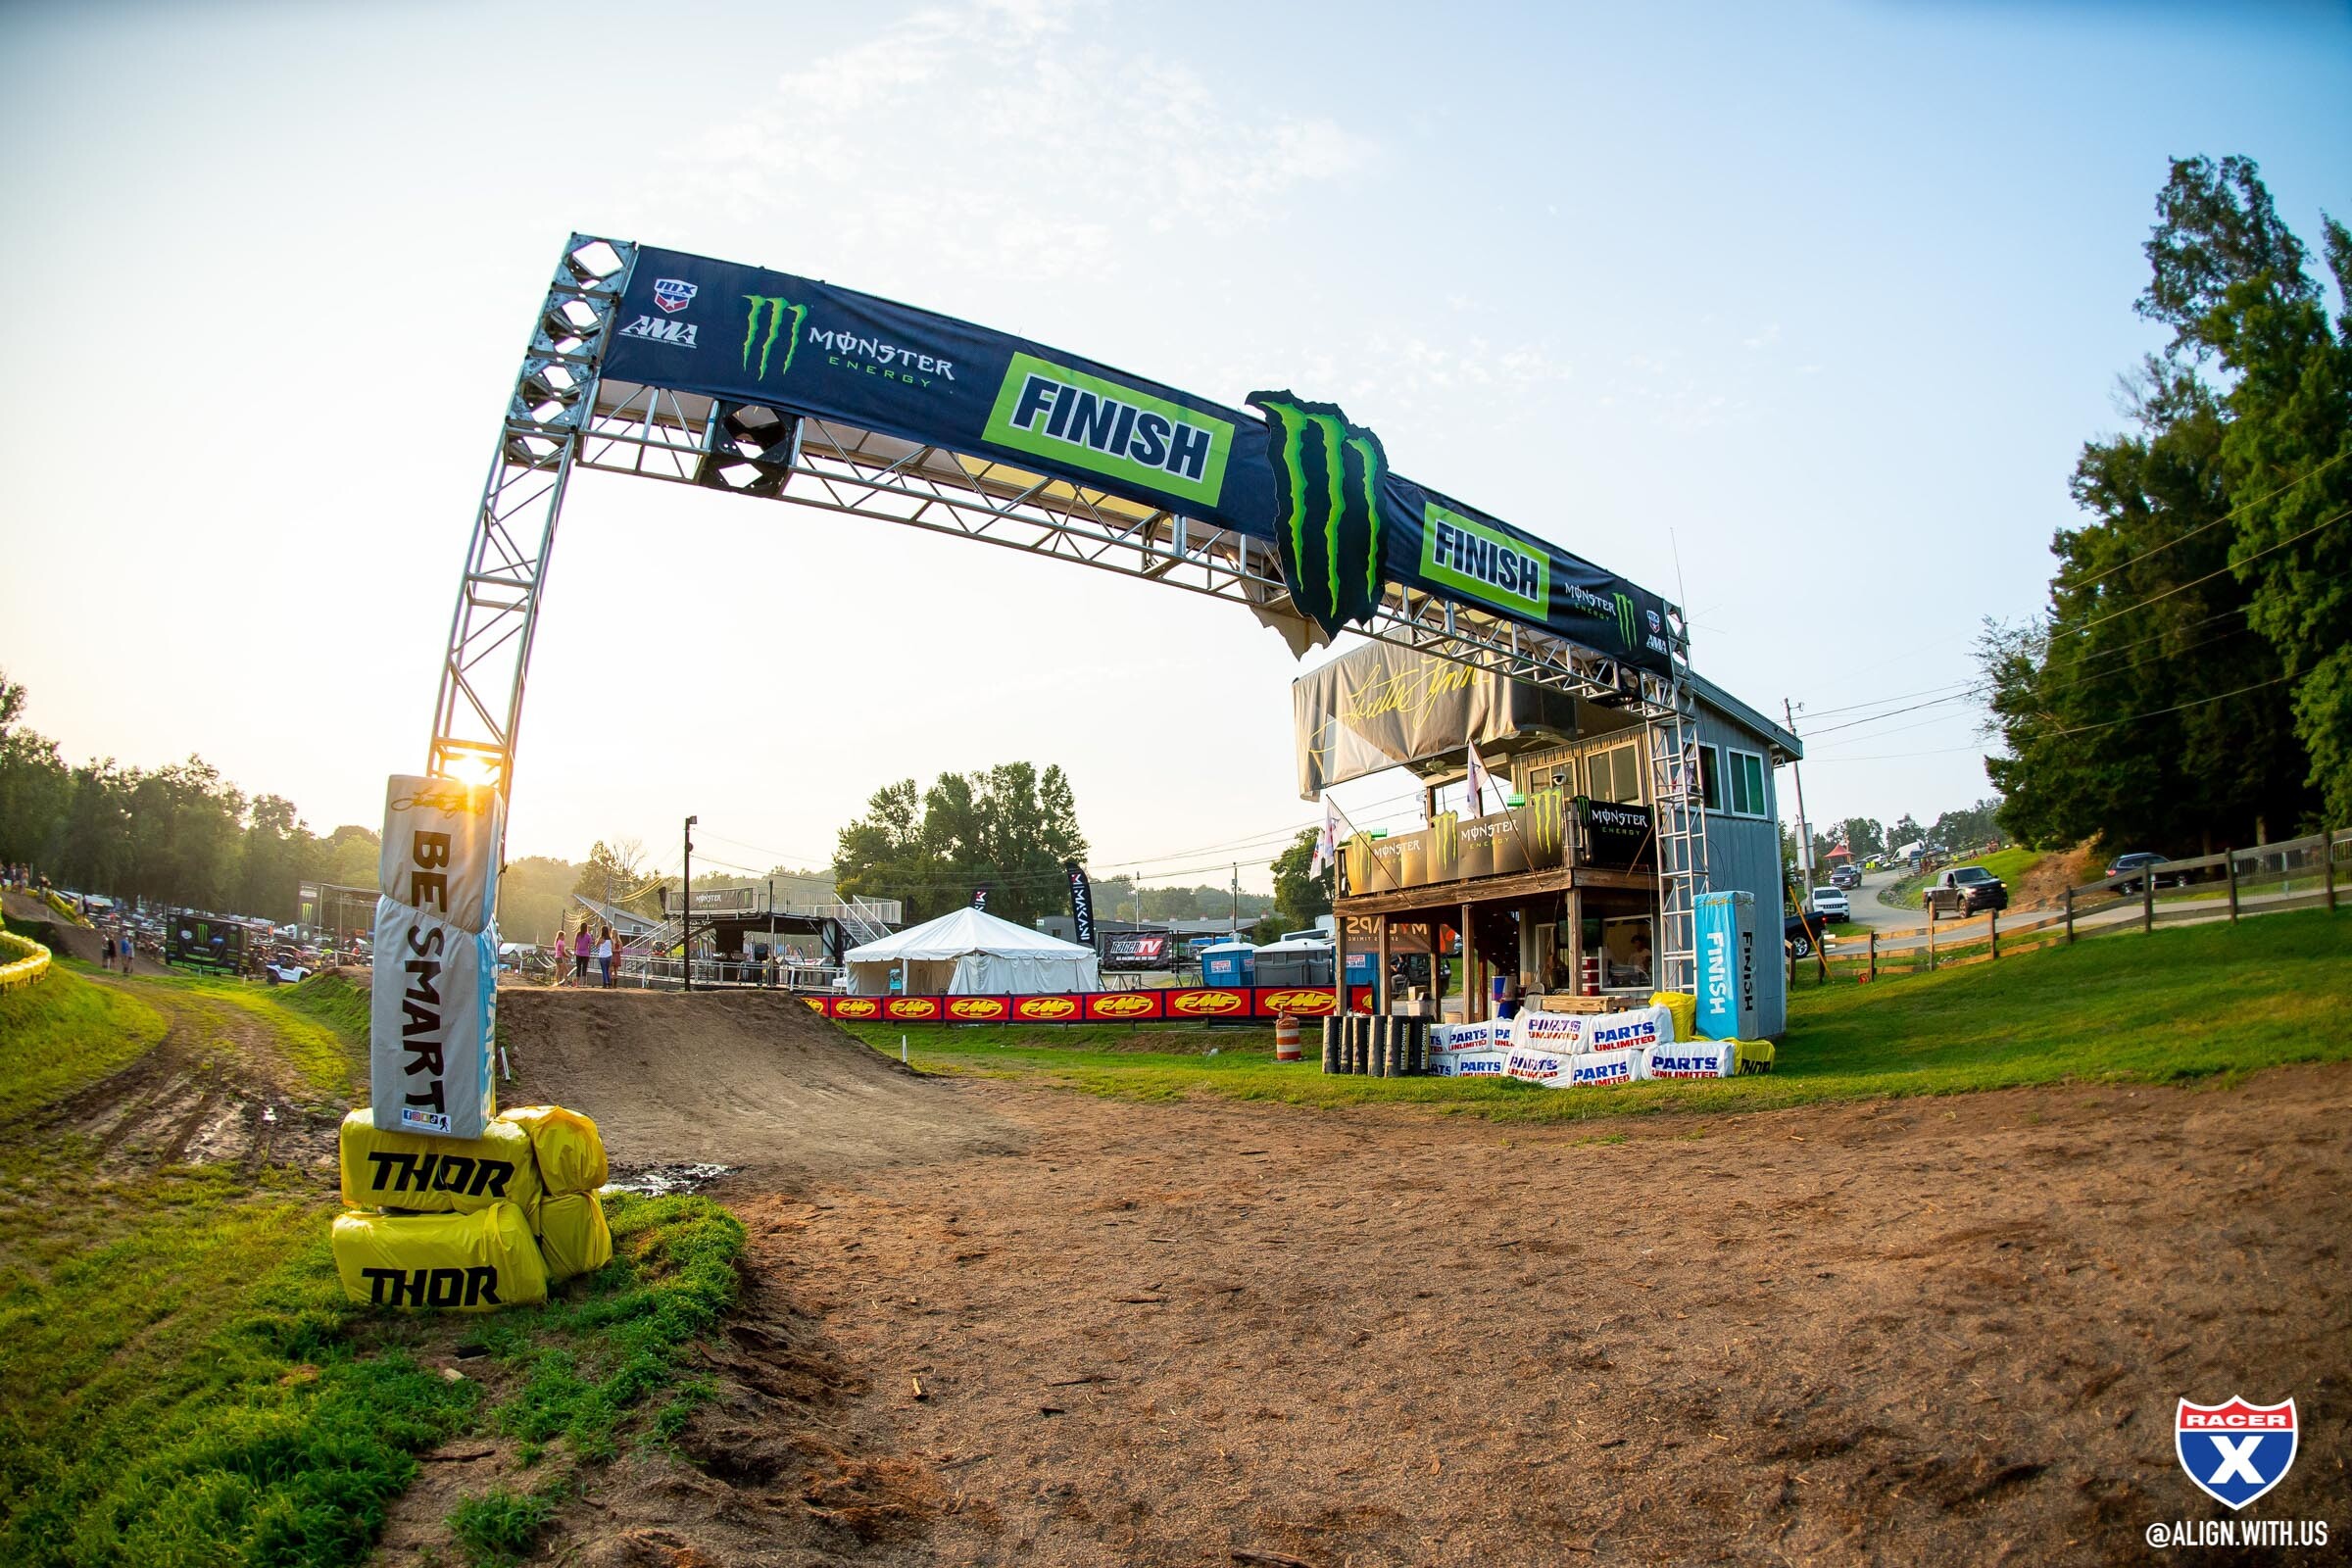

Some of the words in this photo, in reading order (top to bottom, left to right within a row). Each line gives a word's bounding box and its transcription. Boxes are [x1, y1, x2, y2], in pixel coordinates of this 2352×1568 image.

[619, 315, 698, 345] AMA
[808, 326, 956, 380] MONSTER
[828, 356, 931, 388] ENERGY
[1009, 372, 1213, 483] FINISH
[1433, 518, 1540, 604] FINISH
[1565, 582, 1616, 616] MONSTER
[1575, 603, 1610, 621] ENERGY
[1646, 634, 1667, 653] AMA
[1592, 808, 1648, 827] MONSTER
[1461, 819, 1519, 842] MONSTER
[1601, 826, 1641, 836] ENERGY
[1374, 839, 1421, 858] MONSTER
[412, 830, 451, 912] BE
[1707, 932, 1726, 1014] FINISH
[1742, 932, 1753, 1011] FINISH
[836, 1001, 874, 1012] FMF
[890, 1001, 933, 1012] FMF
[951, 1001, 1002, 1012] FMF
[1020, 1000, 1074, 1012] FMF
[1094, 996, 1152, 1011] FMF
[1175, 993, 1240, 1007] FMF
[1265, 993, 1336, 1007] FMF
[402, 925, 445, 1114] SMART
[1529, 1019, 1582, 1032] PARTS
[1450, 1029, 1488, 1044] PARTS
[1594, 1021, 1655, 1043] PARTS
[1594, 1035, 1656, 1052] UNLIMITED
[1461, 1061, 1501, 1072] PARTS
[1509, 1056, 1558, 1070] PARTS
[1573, 1061, 1628, 1081] PARTS
[1651, 1056, 1718, 1070] PARTS
[368, 1151, 516, 1199] THOR
[362, 1265, 503, 1308] THOR
